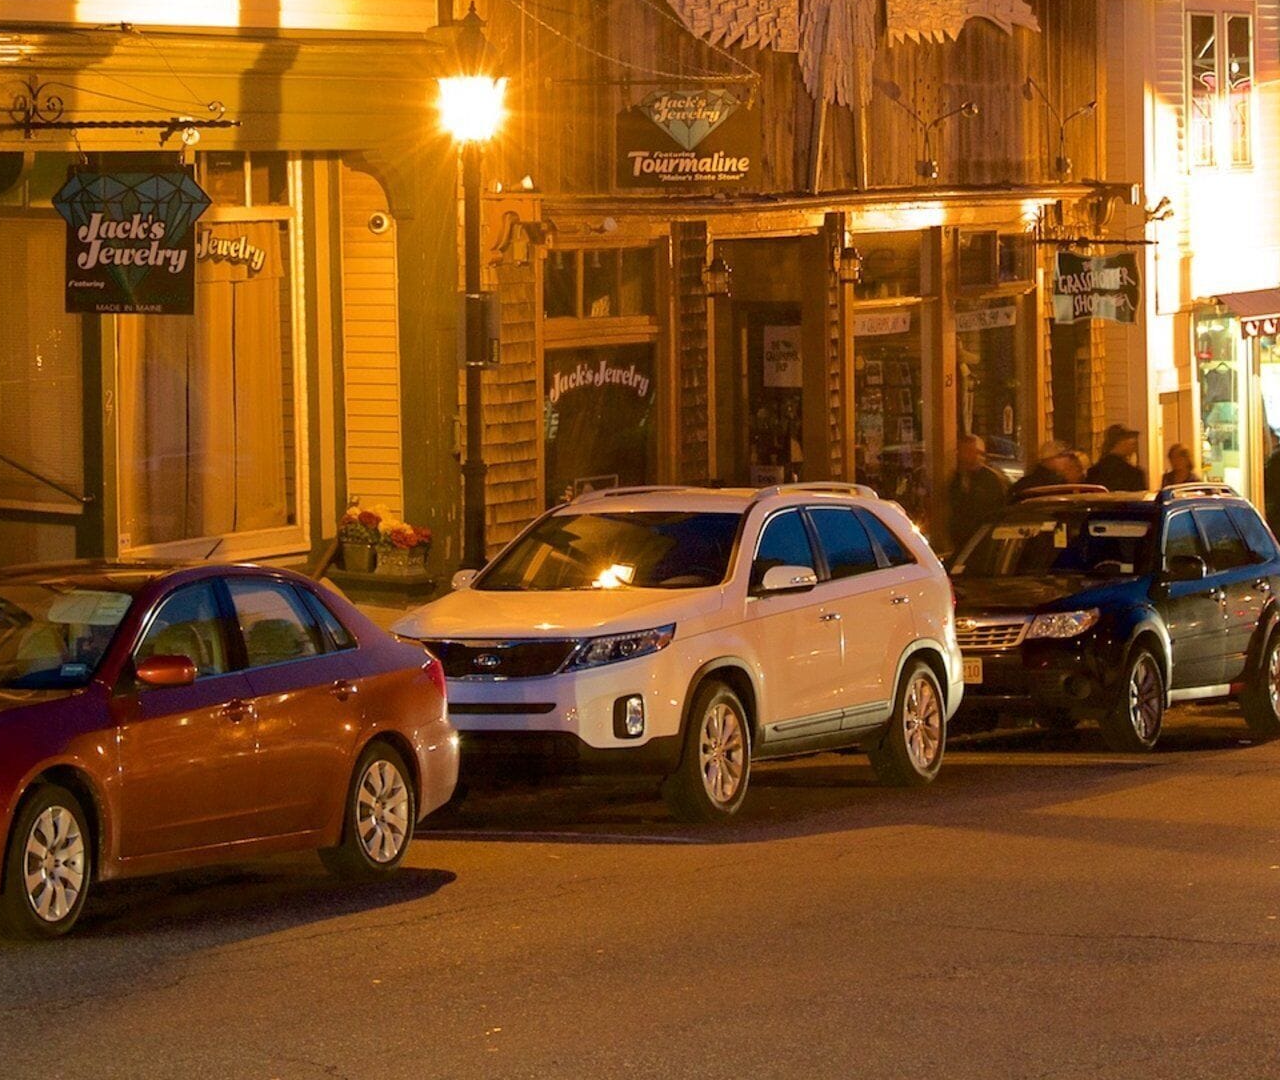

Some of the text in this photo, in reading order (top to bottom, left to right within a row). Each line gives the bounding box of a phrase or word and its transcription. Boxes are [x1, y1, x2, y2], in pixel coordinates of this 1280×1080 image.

[654, 96, 707, 111] Jack's
[655, 107, 721, 122] Jewelry
[653, 151, 696, 159] Featuring
[627, 150, 750, 177] Tourmaline
[694, 173, 716, 181] State
[77, 212, 165, 243] Jack's
[77, 239, 188, 274] Jewelry
[195, 230, 266, 271] Jewelry
[67, 280, 106, 290] Featuring
[96, 304, 163, 313] MADE IN MAINE
[550, 360, 650, 403] Jack's Jewelry
